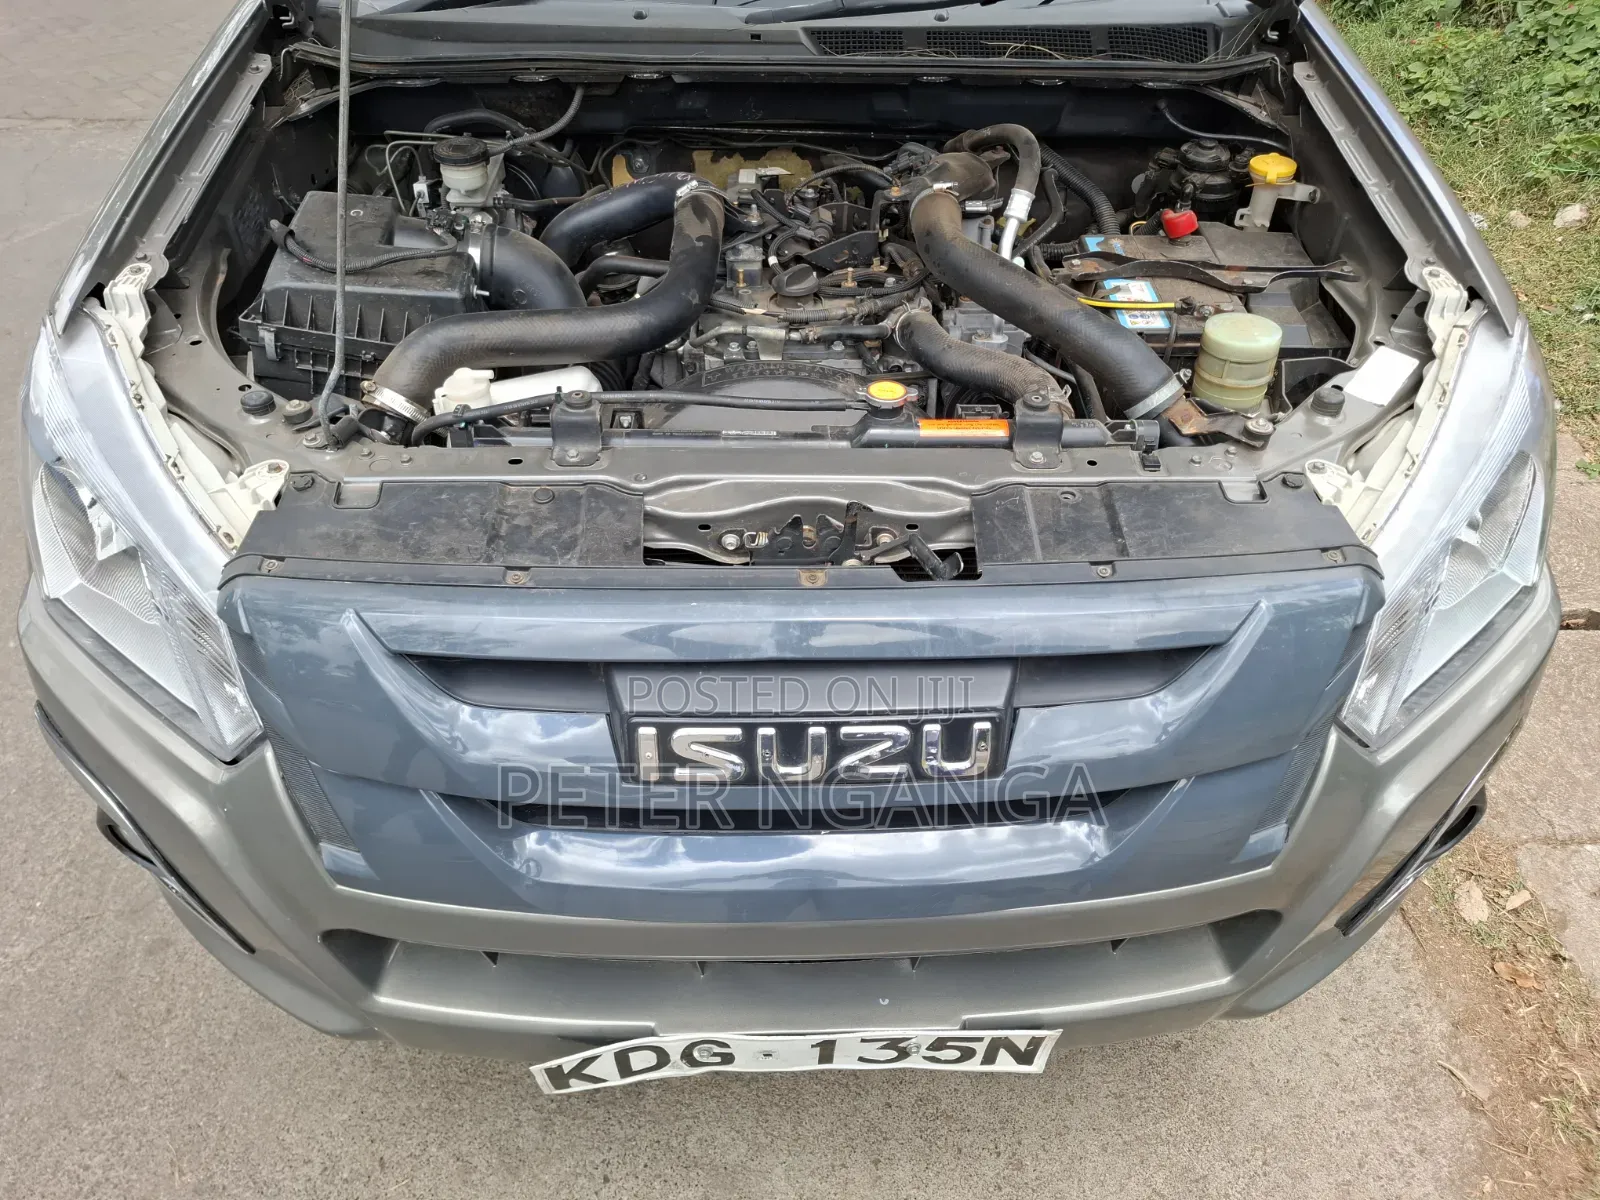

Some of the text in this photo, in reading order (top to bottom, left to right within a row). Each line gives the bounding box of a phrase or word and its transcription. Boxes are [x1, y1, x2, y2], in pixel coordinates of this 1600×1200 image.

[636, 721, 993, 782] ISUZU
[543, 1035, 1048, 1091] KDG 135N
